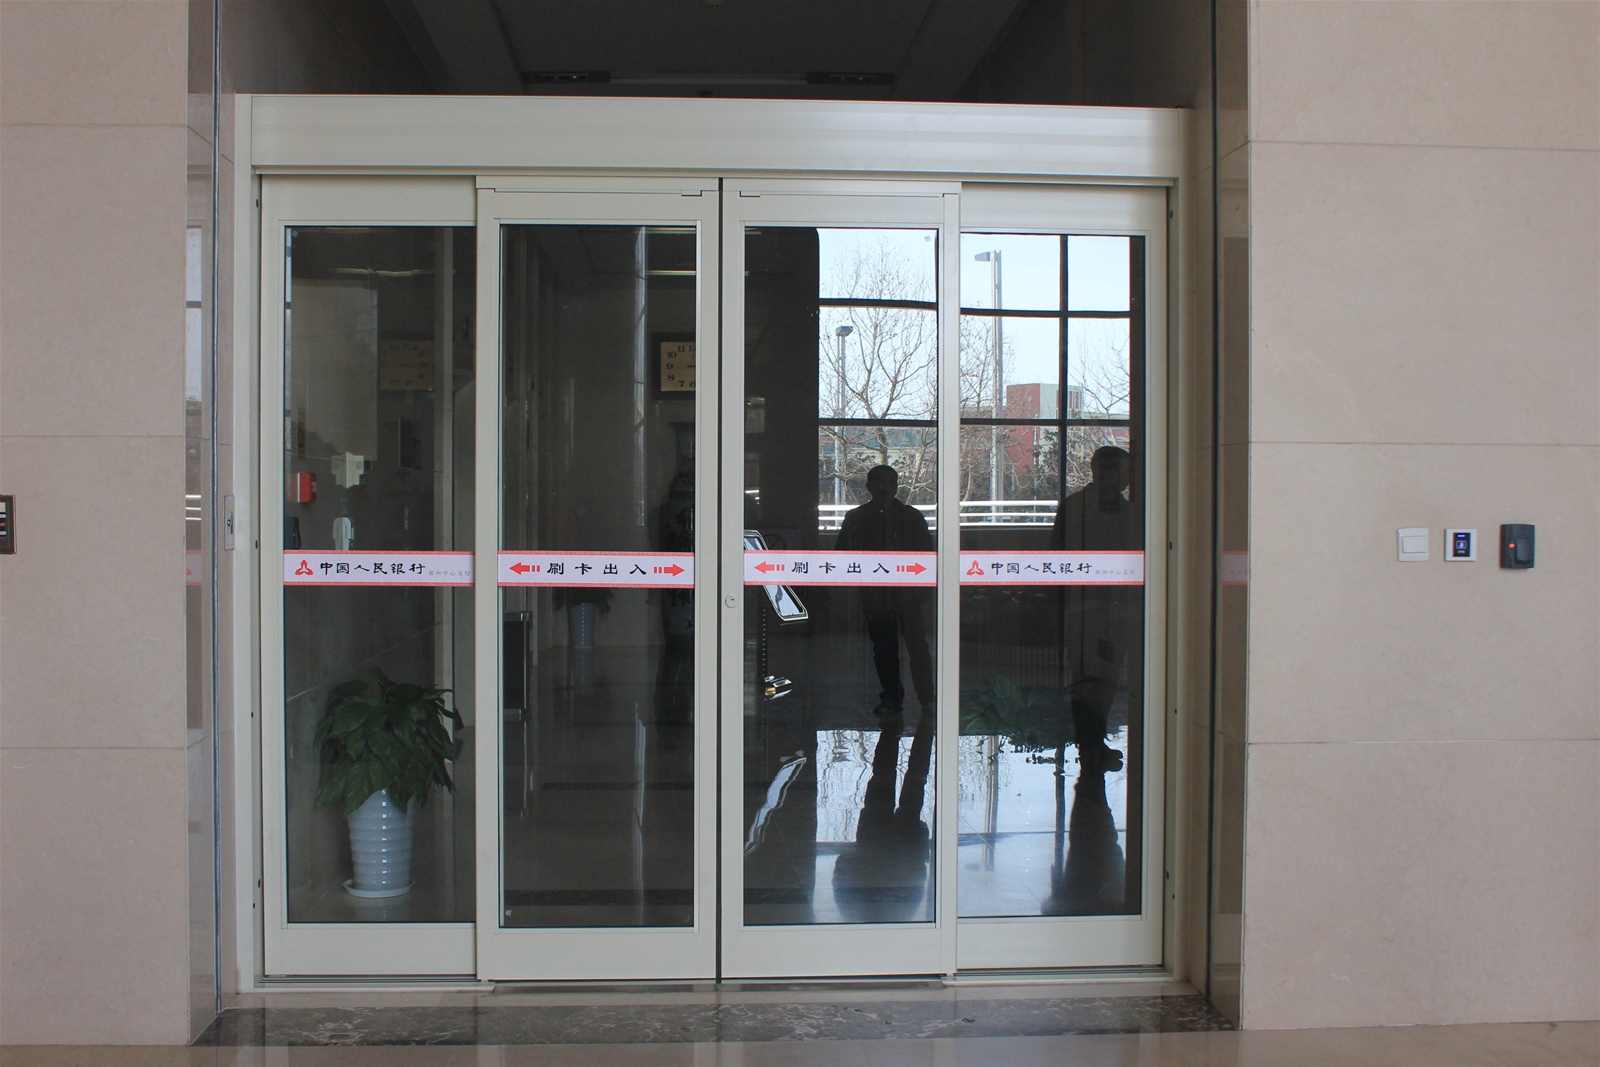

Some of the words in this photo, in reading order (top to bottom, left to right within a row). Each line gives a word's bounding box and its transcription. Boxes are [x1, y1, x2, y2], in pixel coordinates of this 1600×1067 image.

[319, 561, 426, 576] 中国人民银行
[547, 562, 647, 576] 刷卡出入
[791, 561, 890, 575] 刷卡出入
[990, 561, 1093, 576] 中国人民银行
